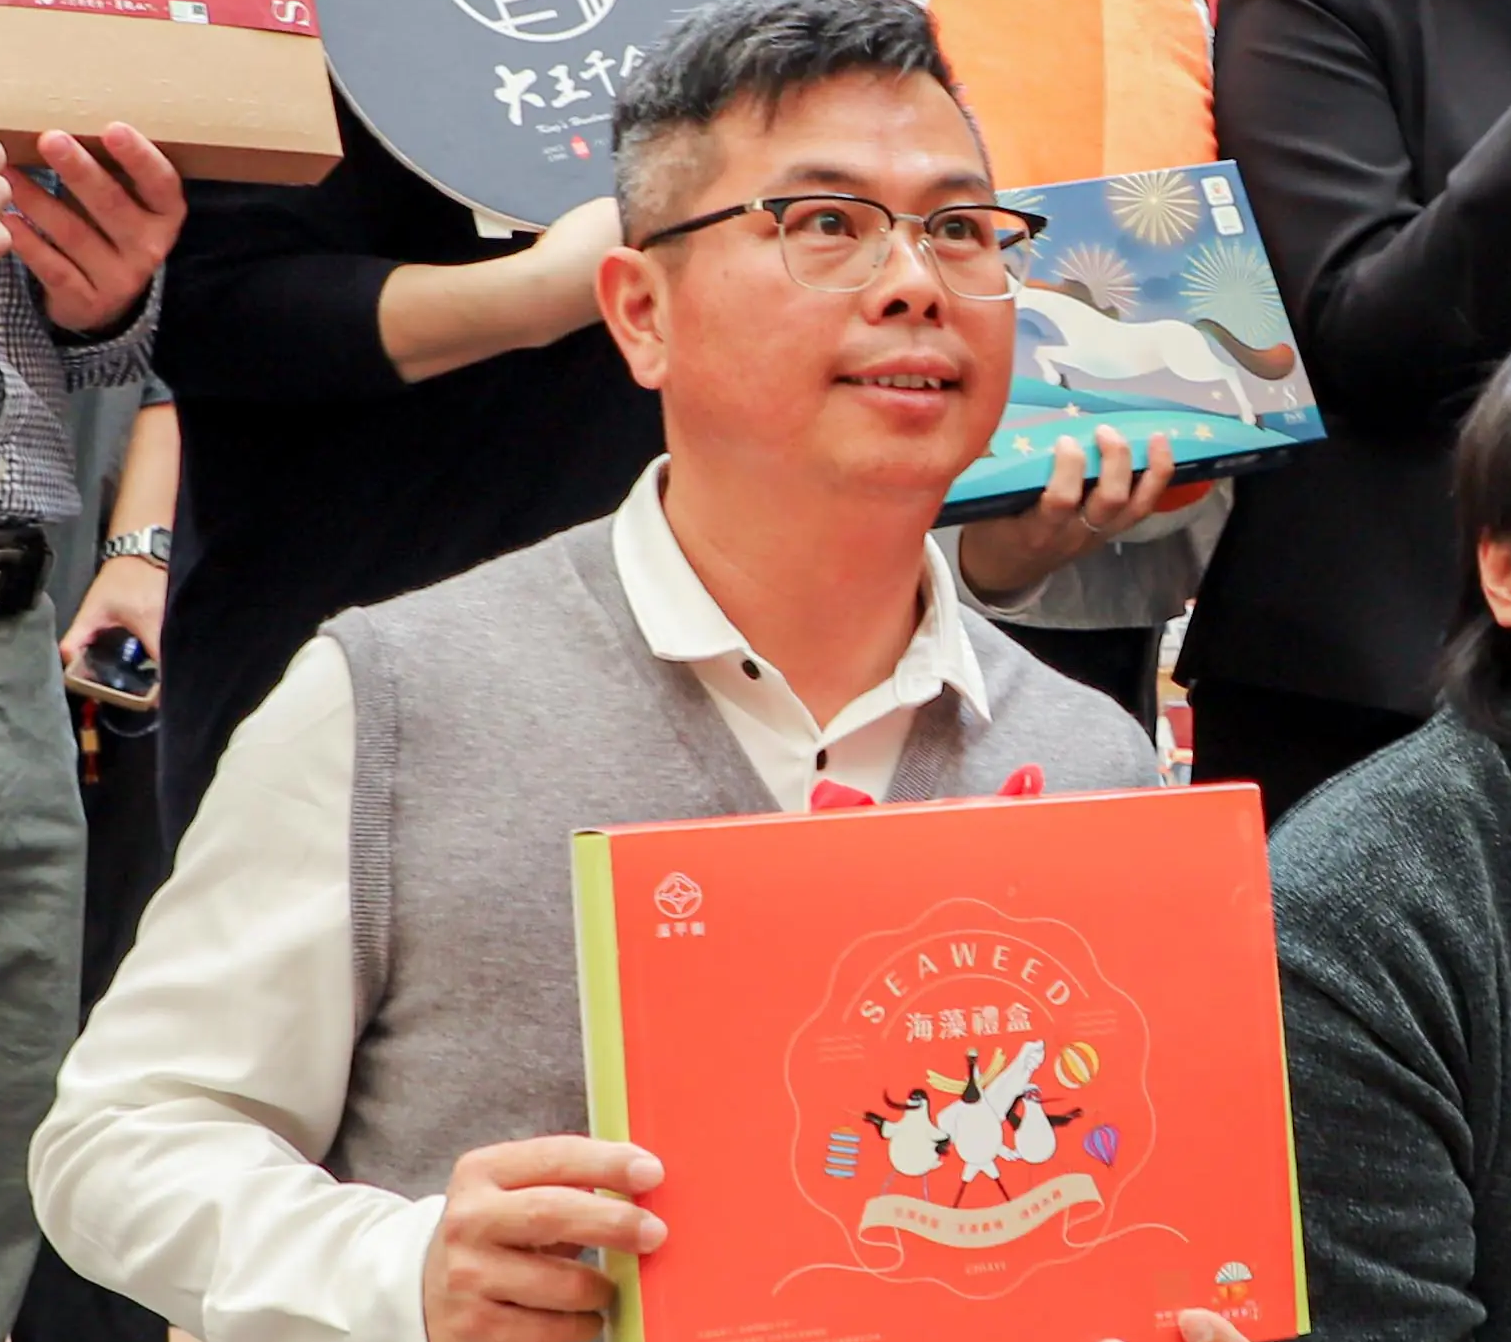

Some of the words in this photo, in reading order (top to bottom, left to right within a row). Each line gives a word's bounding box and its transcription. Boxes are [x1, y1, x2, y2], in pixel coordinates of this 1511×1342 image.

[859, 942, 1071, 1025] SEAWEED
[905, 1001, 1033, 1043] 海藻禮盒
